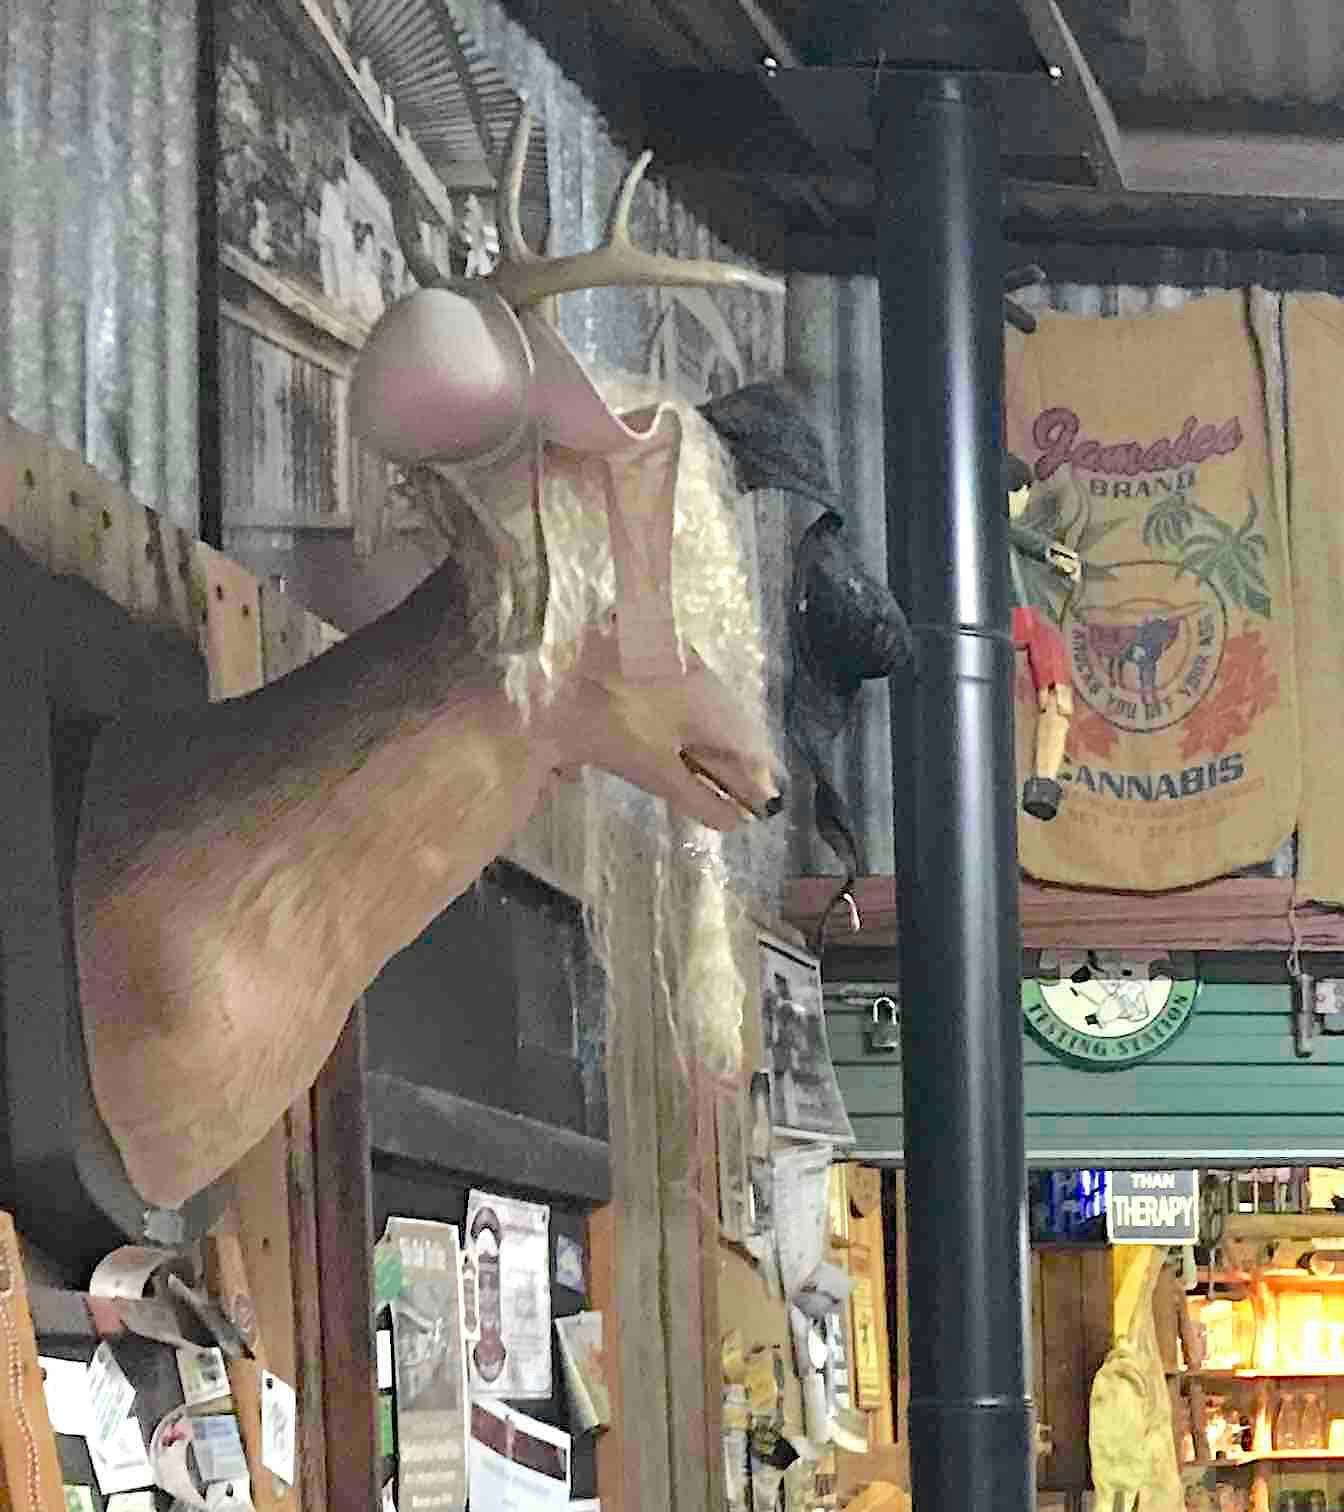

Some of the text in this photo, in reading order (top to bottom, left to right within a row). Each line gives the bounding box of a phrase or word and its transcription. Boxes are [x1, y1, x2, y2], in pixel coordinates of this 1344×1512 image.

[1033, 408, 1244, 480] Jamaica
[1090, 470, 1195, 498] BRAND
[1059, 752, 1246, 801] ANNABIS
[1130, 1172, 1176, 1189] THAN
[1113, 1195, 1194, 1227] THERAPY
